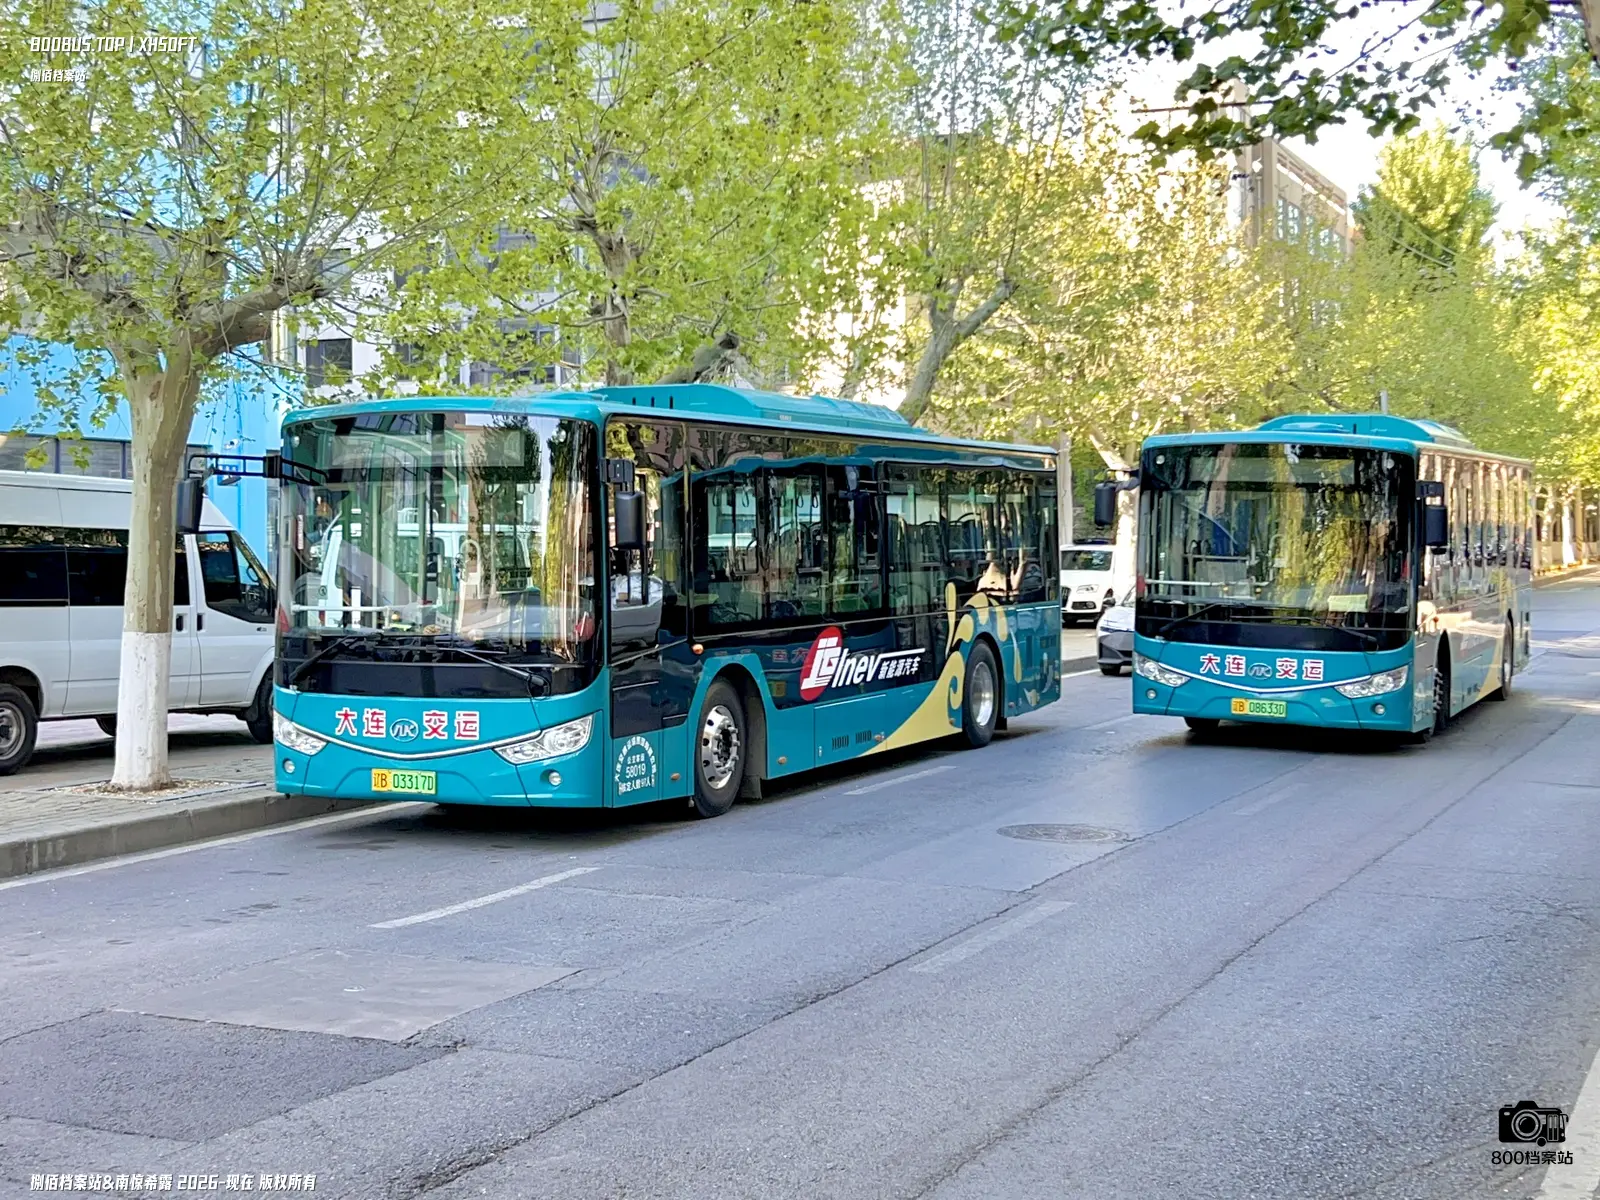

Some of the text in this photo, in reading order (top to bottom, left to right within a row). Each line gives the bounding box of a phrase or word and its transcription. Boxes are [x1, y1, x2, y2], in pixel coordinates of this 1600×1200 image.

[878, 656, 921, 680] 新能源汽车
[625, 763, 647, 779] 58019
